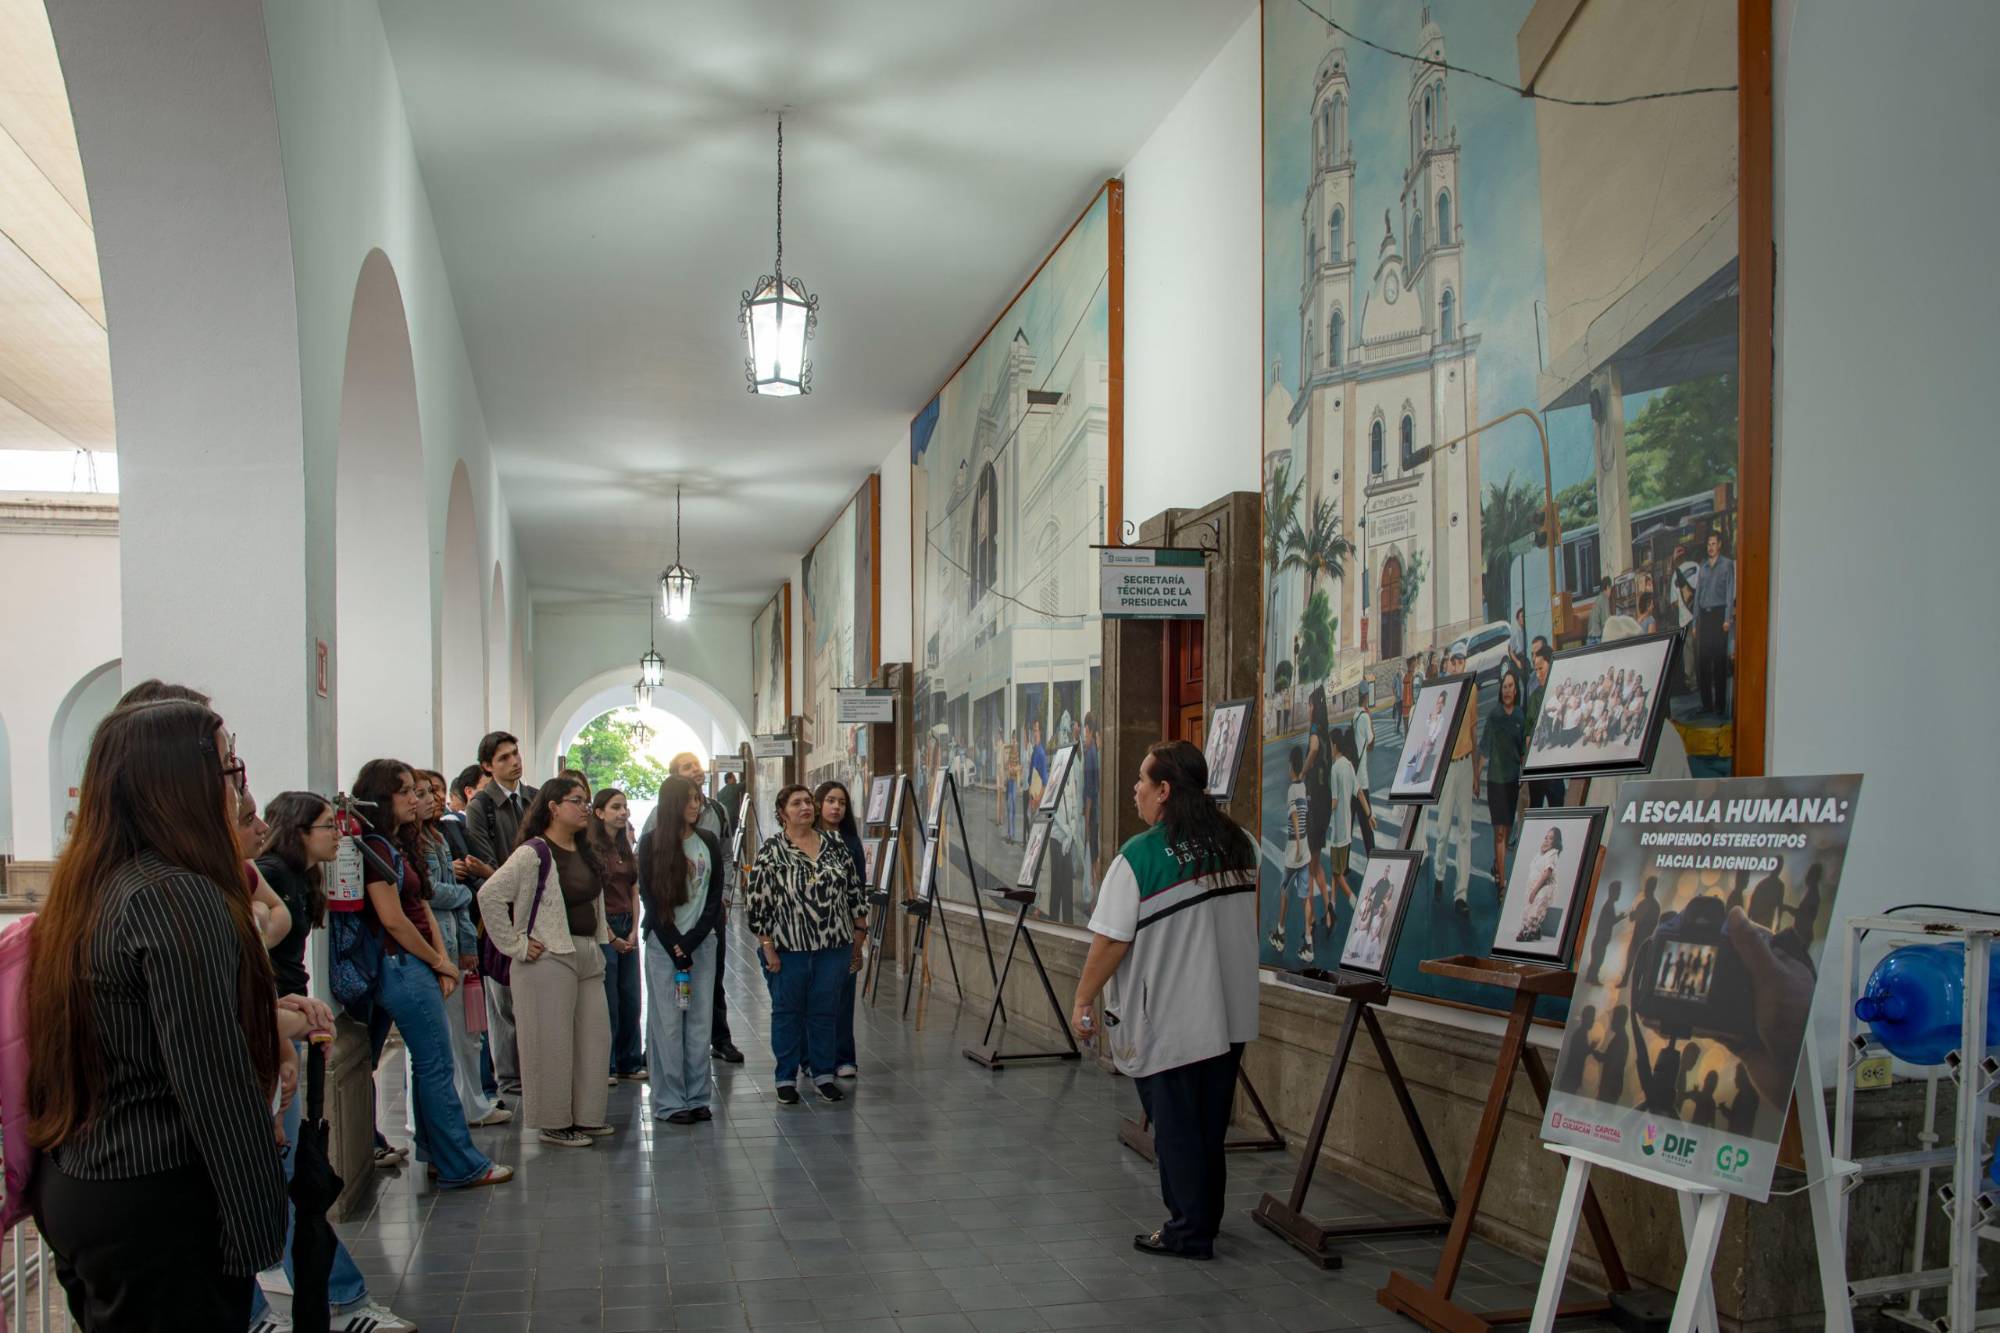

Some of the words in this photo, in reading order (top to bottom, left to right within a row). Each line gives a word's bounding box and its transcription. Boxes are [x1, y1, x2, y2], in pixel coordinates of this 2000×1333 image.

[1123, 574, 1185, 584] SECRETARÍA
[1117, 585, 1160, 595] TÉCNICA
[1163, 587, 1176, 595] DE
[1179, 587, 1192, 595] LA
[1121, 598, 1188, 607] PRESIDENCIA
[1621, 801, 1637, 823] A
[1640, 800, 1721, 823] ESCALA
[1724, 798, 1848, 823] HUMANA:
[1641, 832, 1710, 847] ROMPIENDO
[1712, 833, 1806, 848] ESTEREOTIPOS
[1656, 855, 1695, 868] HACIA
[1696, 856, 1710, 869] LA
[1712, 856, 1778, 871] DIGNIDAD
[1595, 1124, 1621, 1138] CAPITAL
[1663, 1134, 1697, 1157] DIF
[1717, 1144, 1749, 1173] GP
